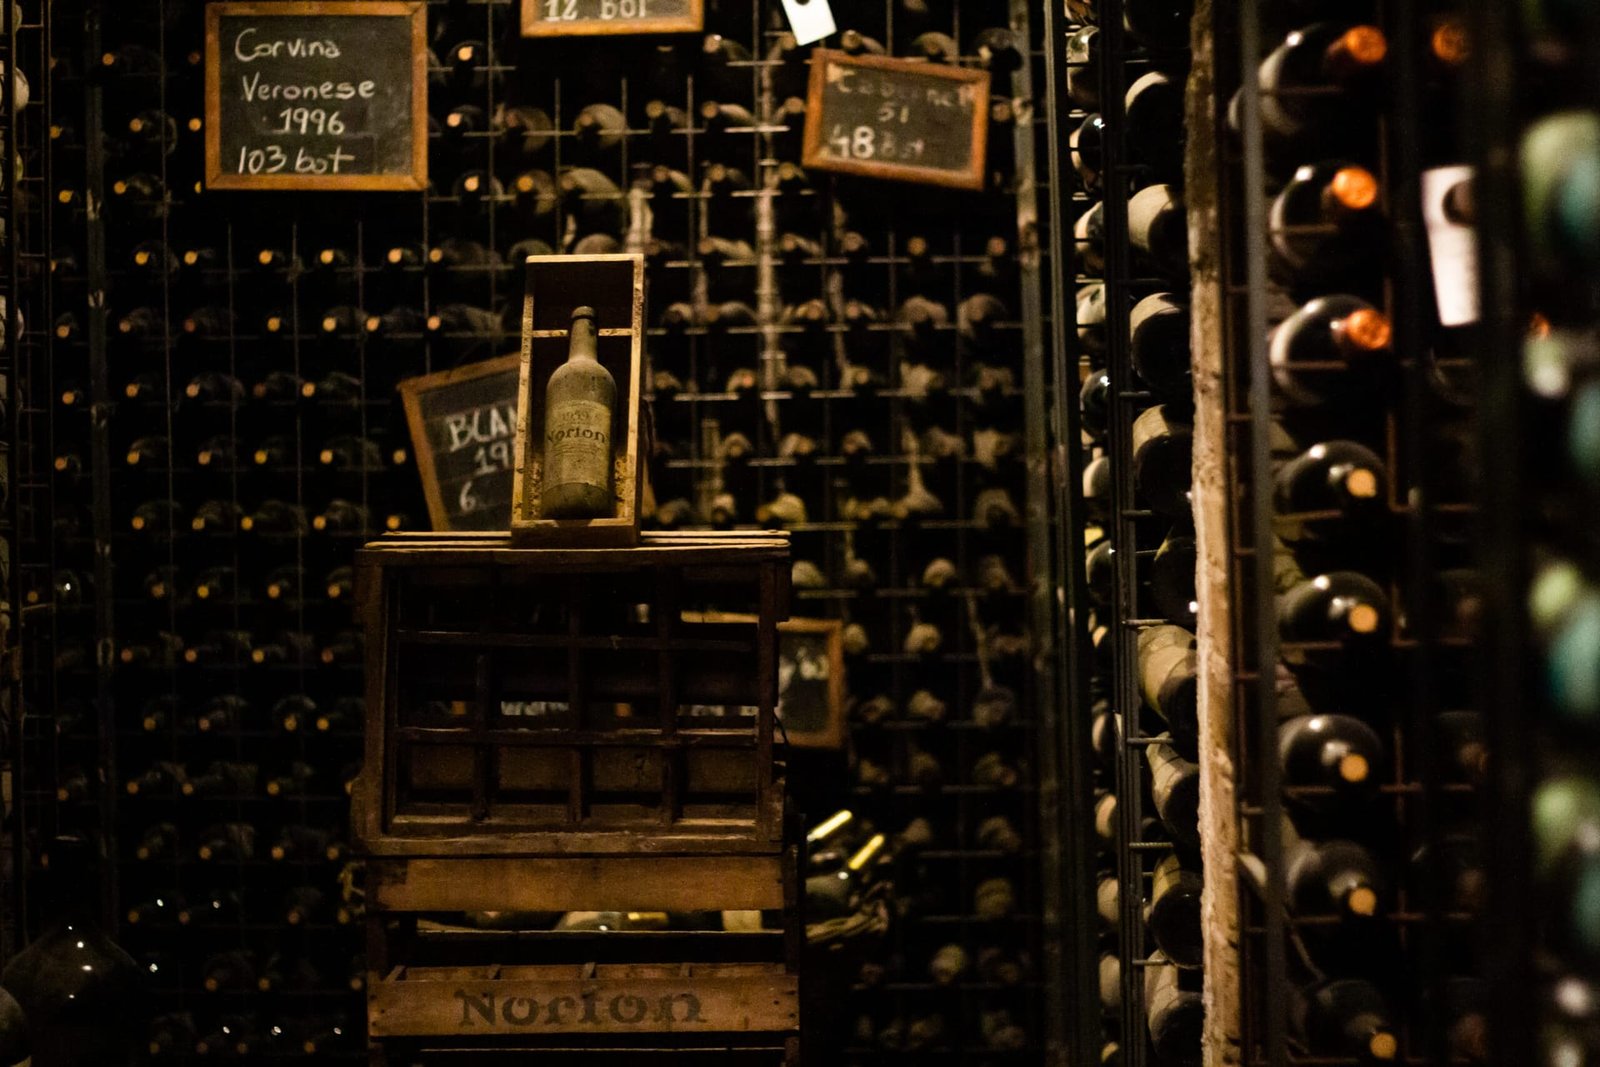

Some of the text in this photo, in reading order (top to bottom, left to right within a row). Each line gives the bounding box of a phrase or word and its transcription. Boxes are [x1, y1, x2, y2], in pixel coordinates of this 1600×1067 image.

[235, 28, 341, 61] Corvina
[241, 71, 375, 101] Veronese
[279, 107, 345, 135] 1996
[829, 124, 875, 159] 48
[238, 145, 356, 175] 103 bot
[473, 439, 516, 476] 19
[454, 986, 708, 1028] Norton
